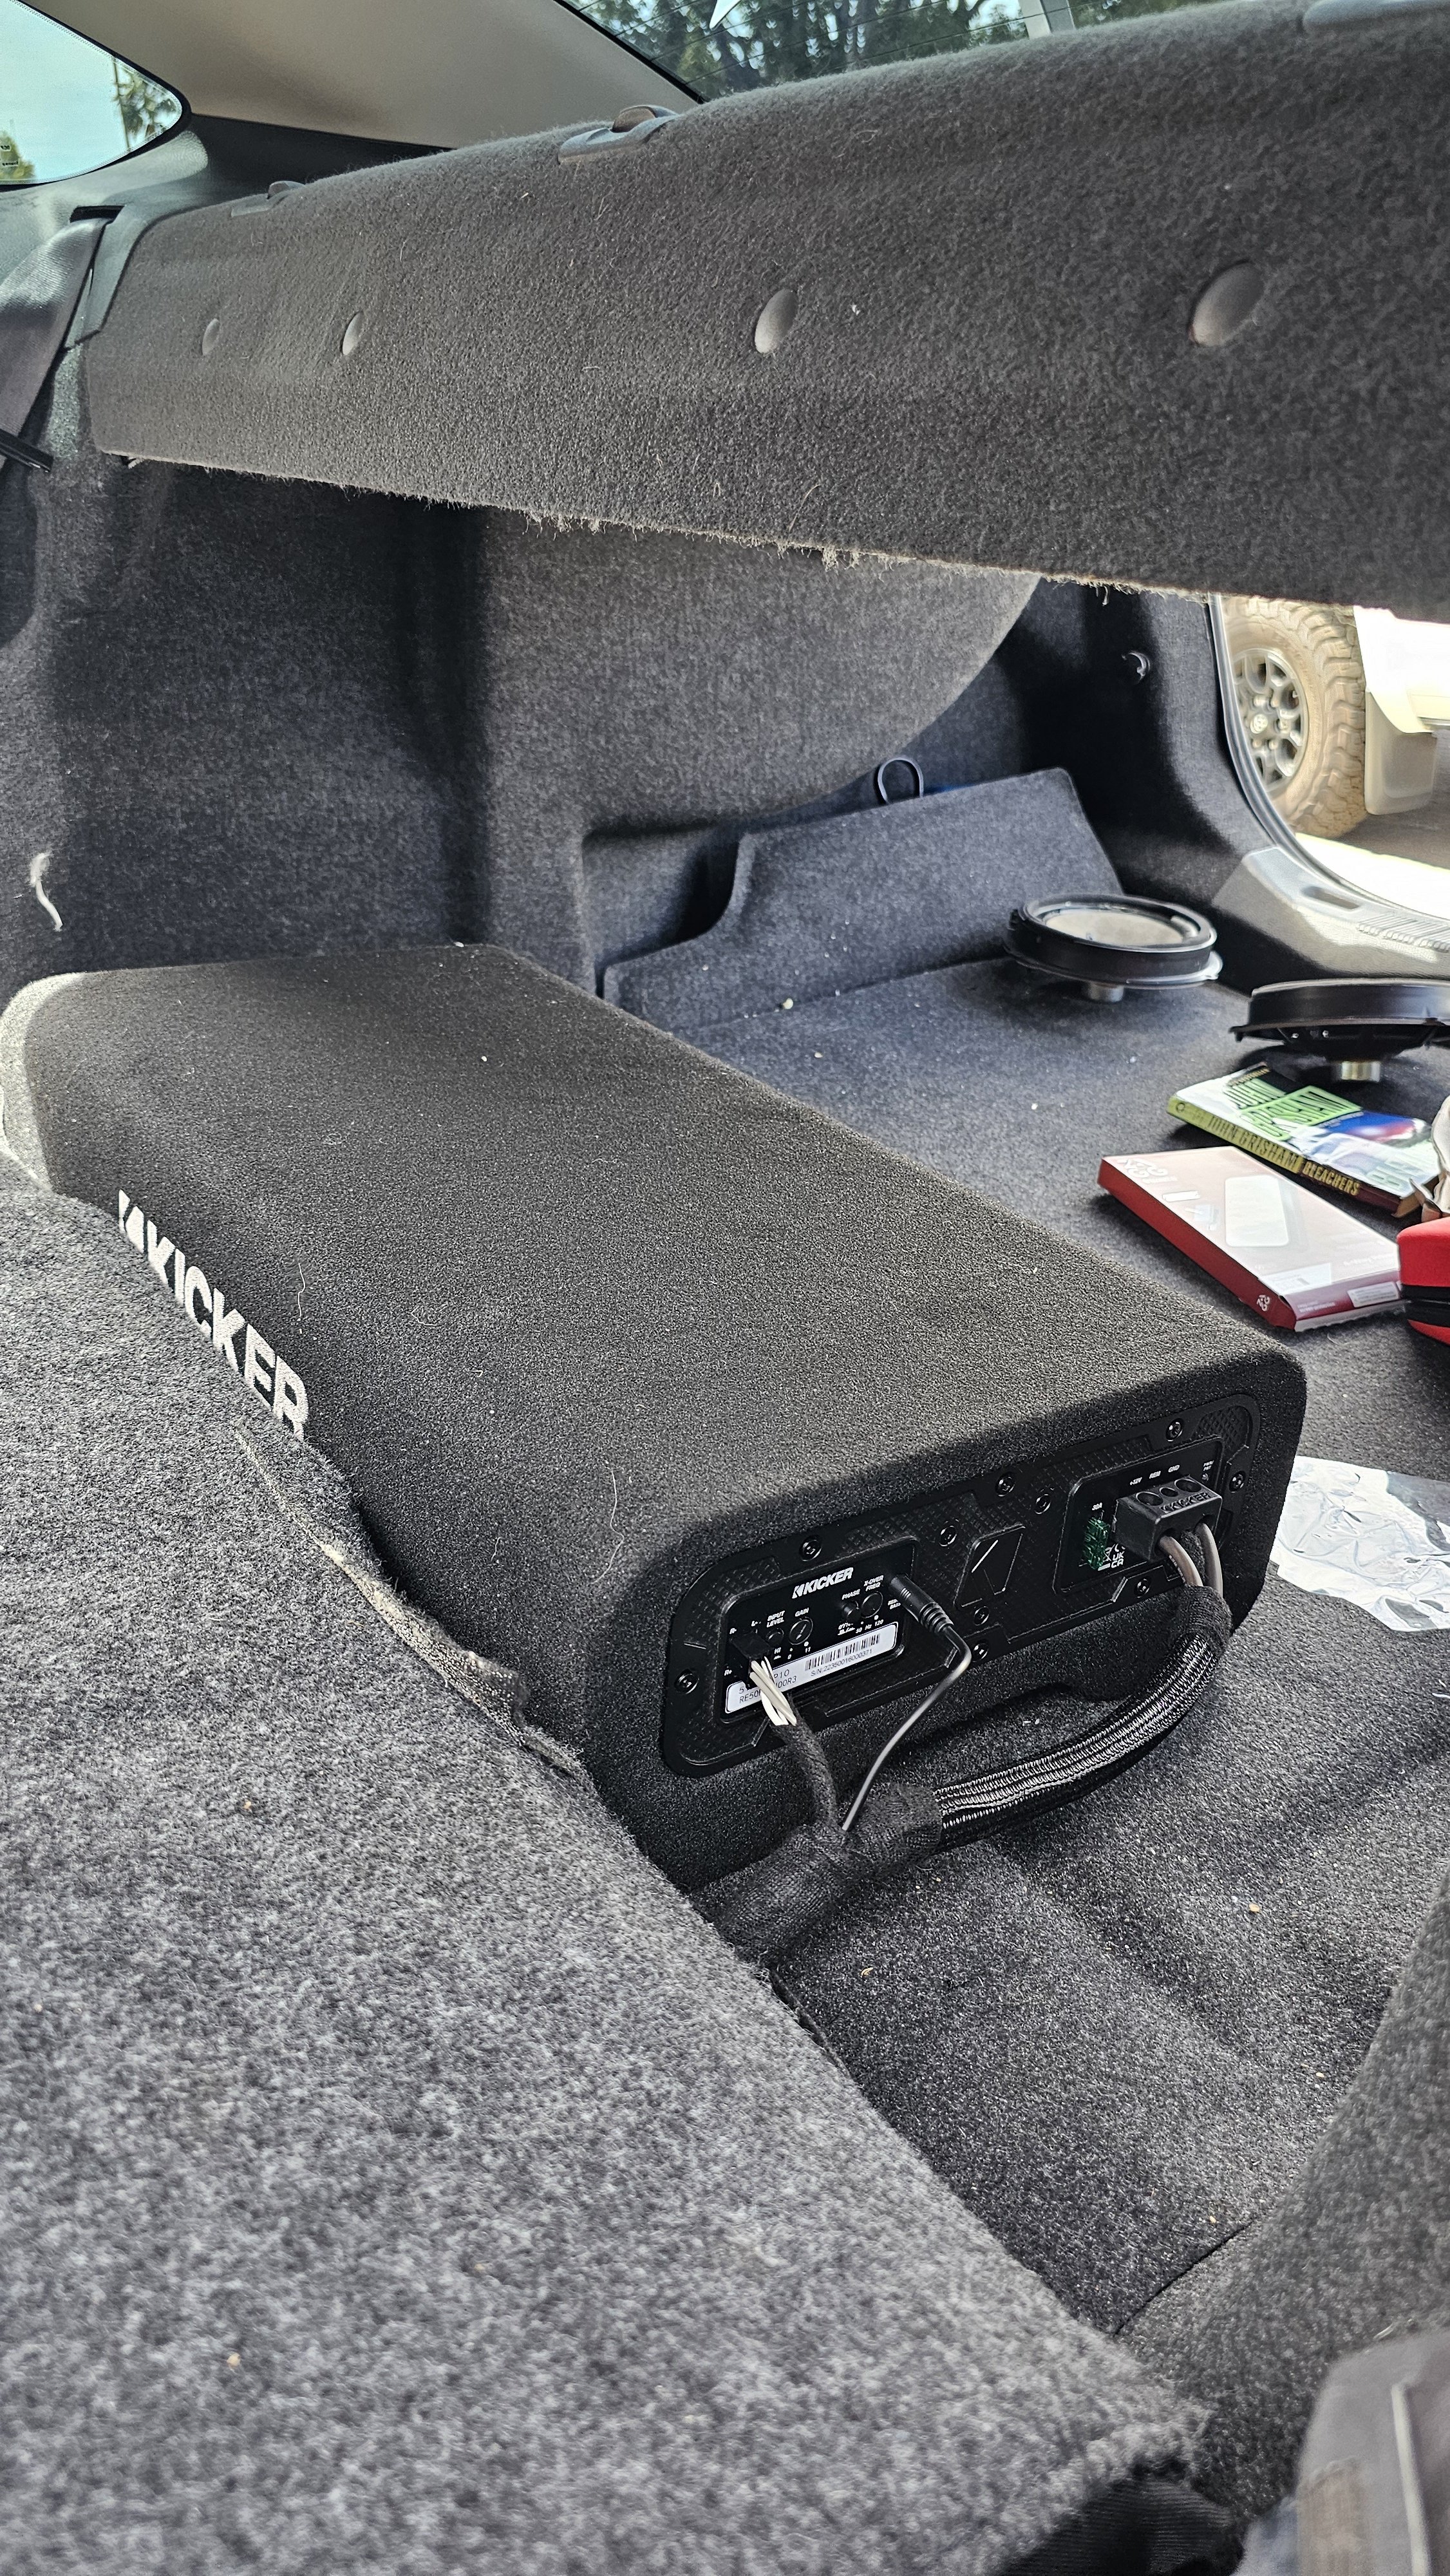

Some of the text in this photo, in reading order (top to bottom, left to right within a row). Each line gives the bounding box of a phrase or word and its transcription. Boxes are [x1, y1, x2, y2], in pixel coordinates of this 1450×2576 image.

[1207, 1115, 1236, 1140] JOHN
[1238, 1132, 1299, 1170] GRISHAM
[1302, 1160, 1360, 1196] BLEACHERS
[147, 1220, 309, 1441] KICKER
[1112, 1550, 1125, 1560] UK
[1111, 1558, 1124, 1568] CA
[802, 1567, 854, 1595] KICKER
[841, 1588, 861, 1600] PHASE
[767, 1610, 786, 1622] INPUT
[795, 1607, 809, 1618] GAIN
[766, 1616, 785, 1628] LEVEL
